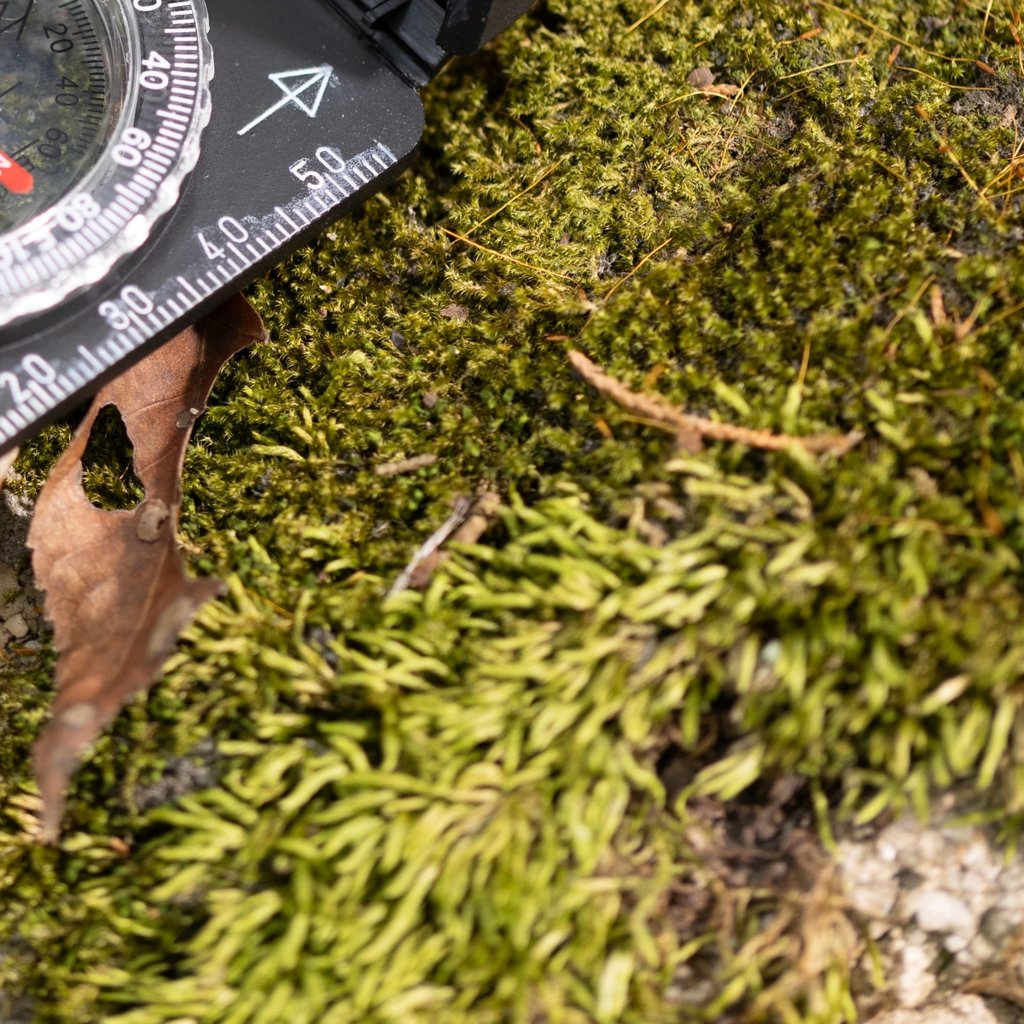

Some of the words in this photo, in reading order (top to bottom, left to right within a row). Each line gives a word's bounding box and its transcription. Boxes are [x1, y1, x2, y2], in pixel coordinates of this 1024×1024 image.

[43, 23, 73, 54] 20
[55, 75, 79, 106] 40
[139, 50, 170, 91] 40
[38, 128, 68, 158] 60
[111, 127, 152, 168] 60
[289, 146, 345, 190] 50
[57, 192, 101, 232] 80
[197, 216, 249, 260] 40
[98, 284, 154, 328] 30
